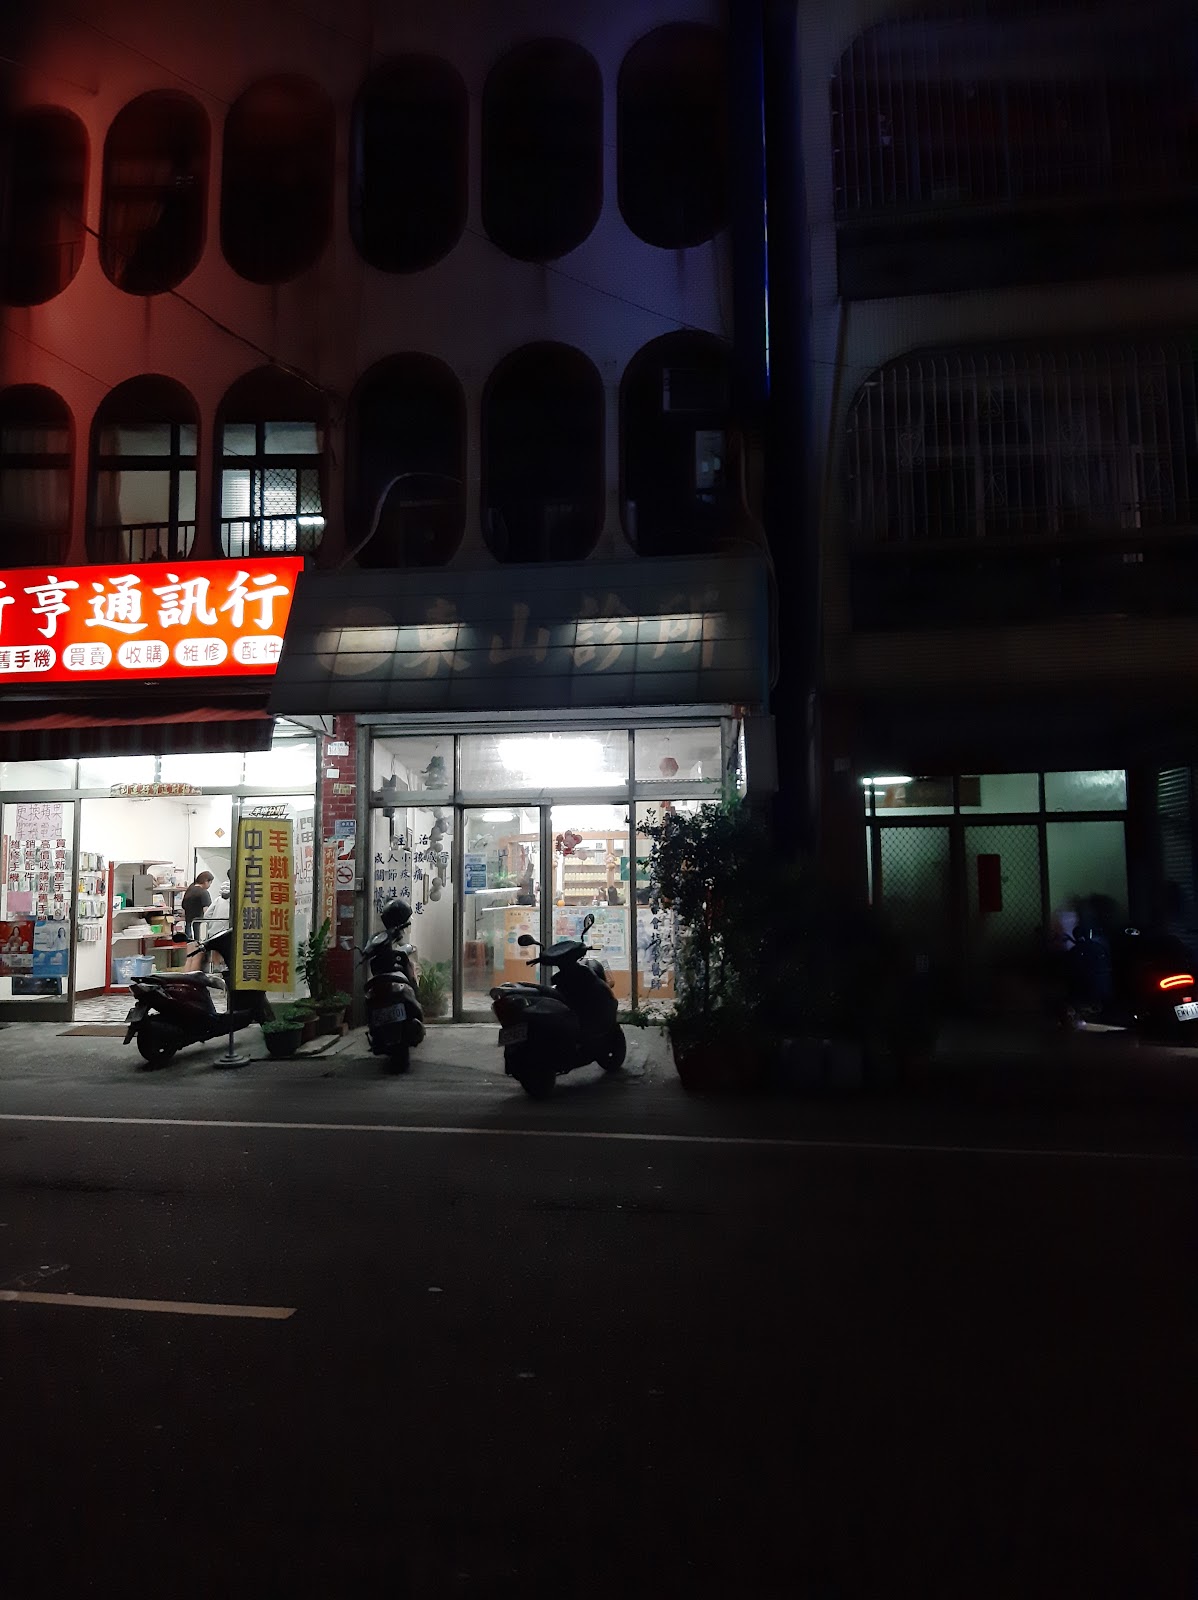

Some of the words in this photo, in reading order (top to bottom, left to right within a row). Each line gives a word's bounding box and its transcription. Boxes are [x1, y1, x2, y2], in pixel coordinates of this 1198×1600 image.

[70, 647, 105, 666] 買賣
[125, 645, 163, 664] 收購
[183, 644, 221, 661] 維修
[242, 642, 280, 659] 配件
[9, 839, 20, 882] 維修手機
[24, 839, 35, 882] 銷售配件
[54, 839, 66, 903] 買賣新舊手機
